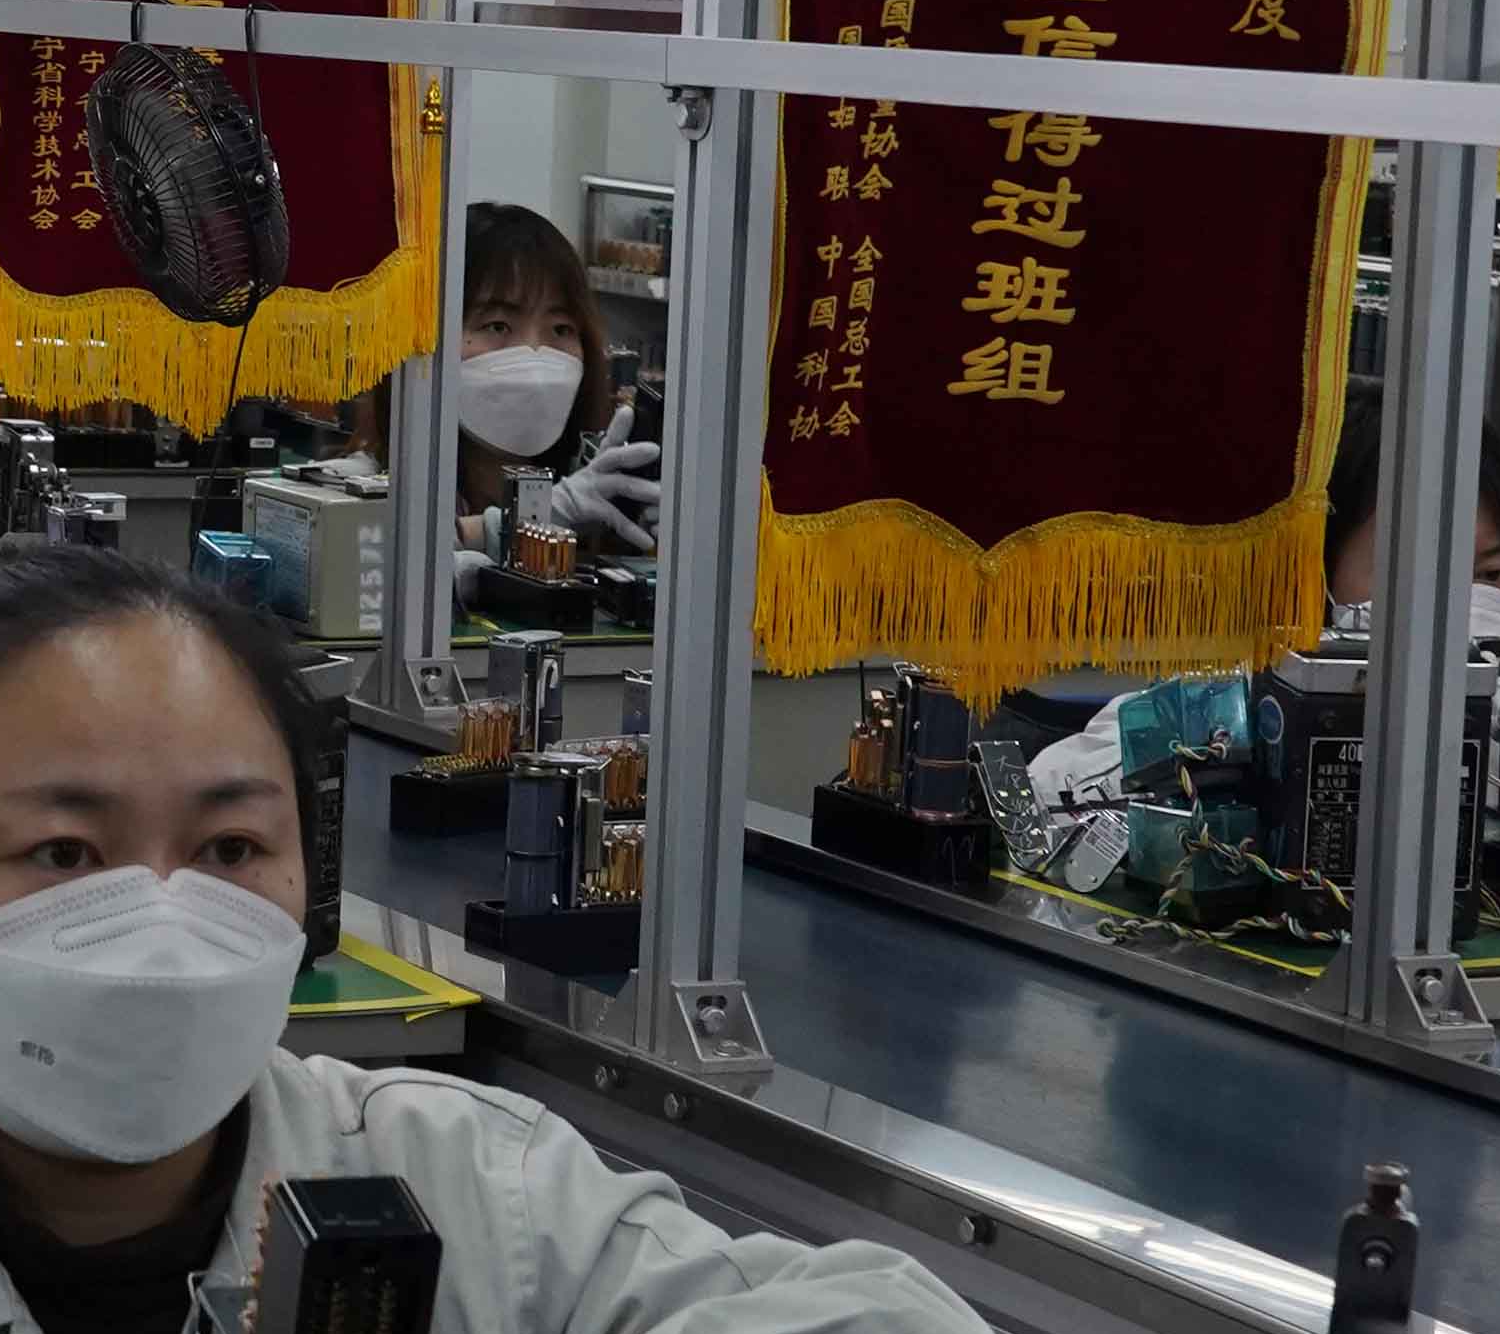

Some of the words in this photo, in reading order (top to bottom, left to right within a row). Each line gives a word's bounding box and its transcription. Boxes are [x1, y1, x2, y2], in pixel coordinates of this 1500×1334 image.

[27, 36, 65, 231] 宁省科学技术协会
[788, 234, 844, 443] 中国科协
[825, 234, 883, 438] 全国总工会
